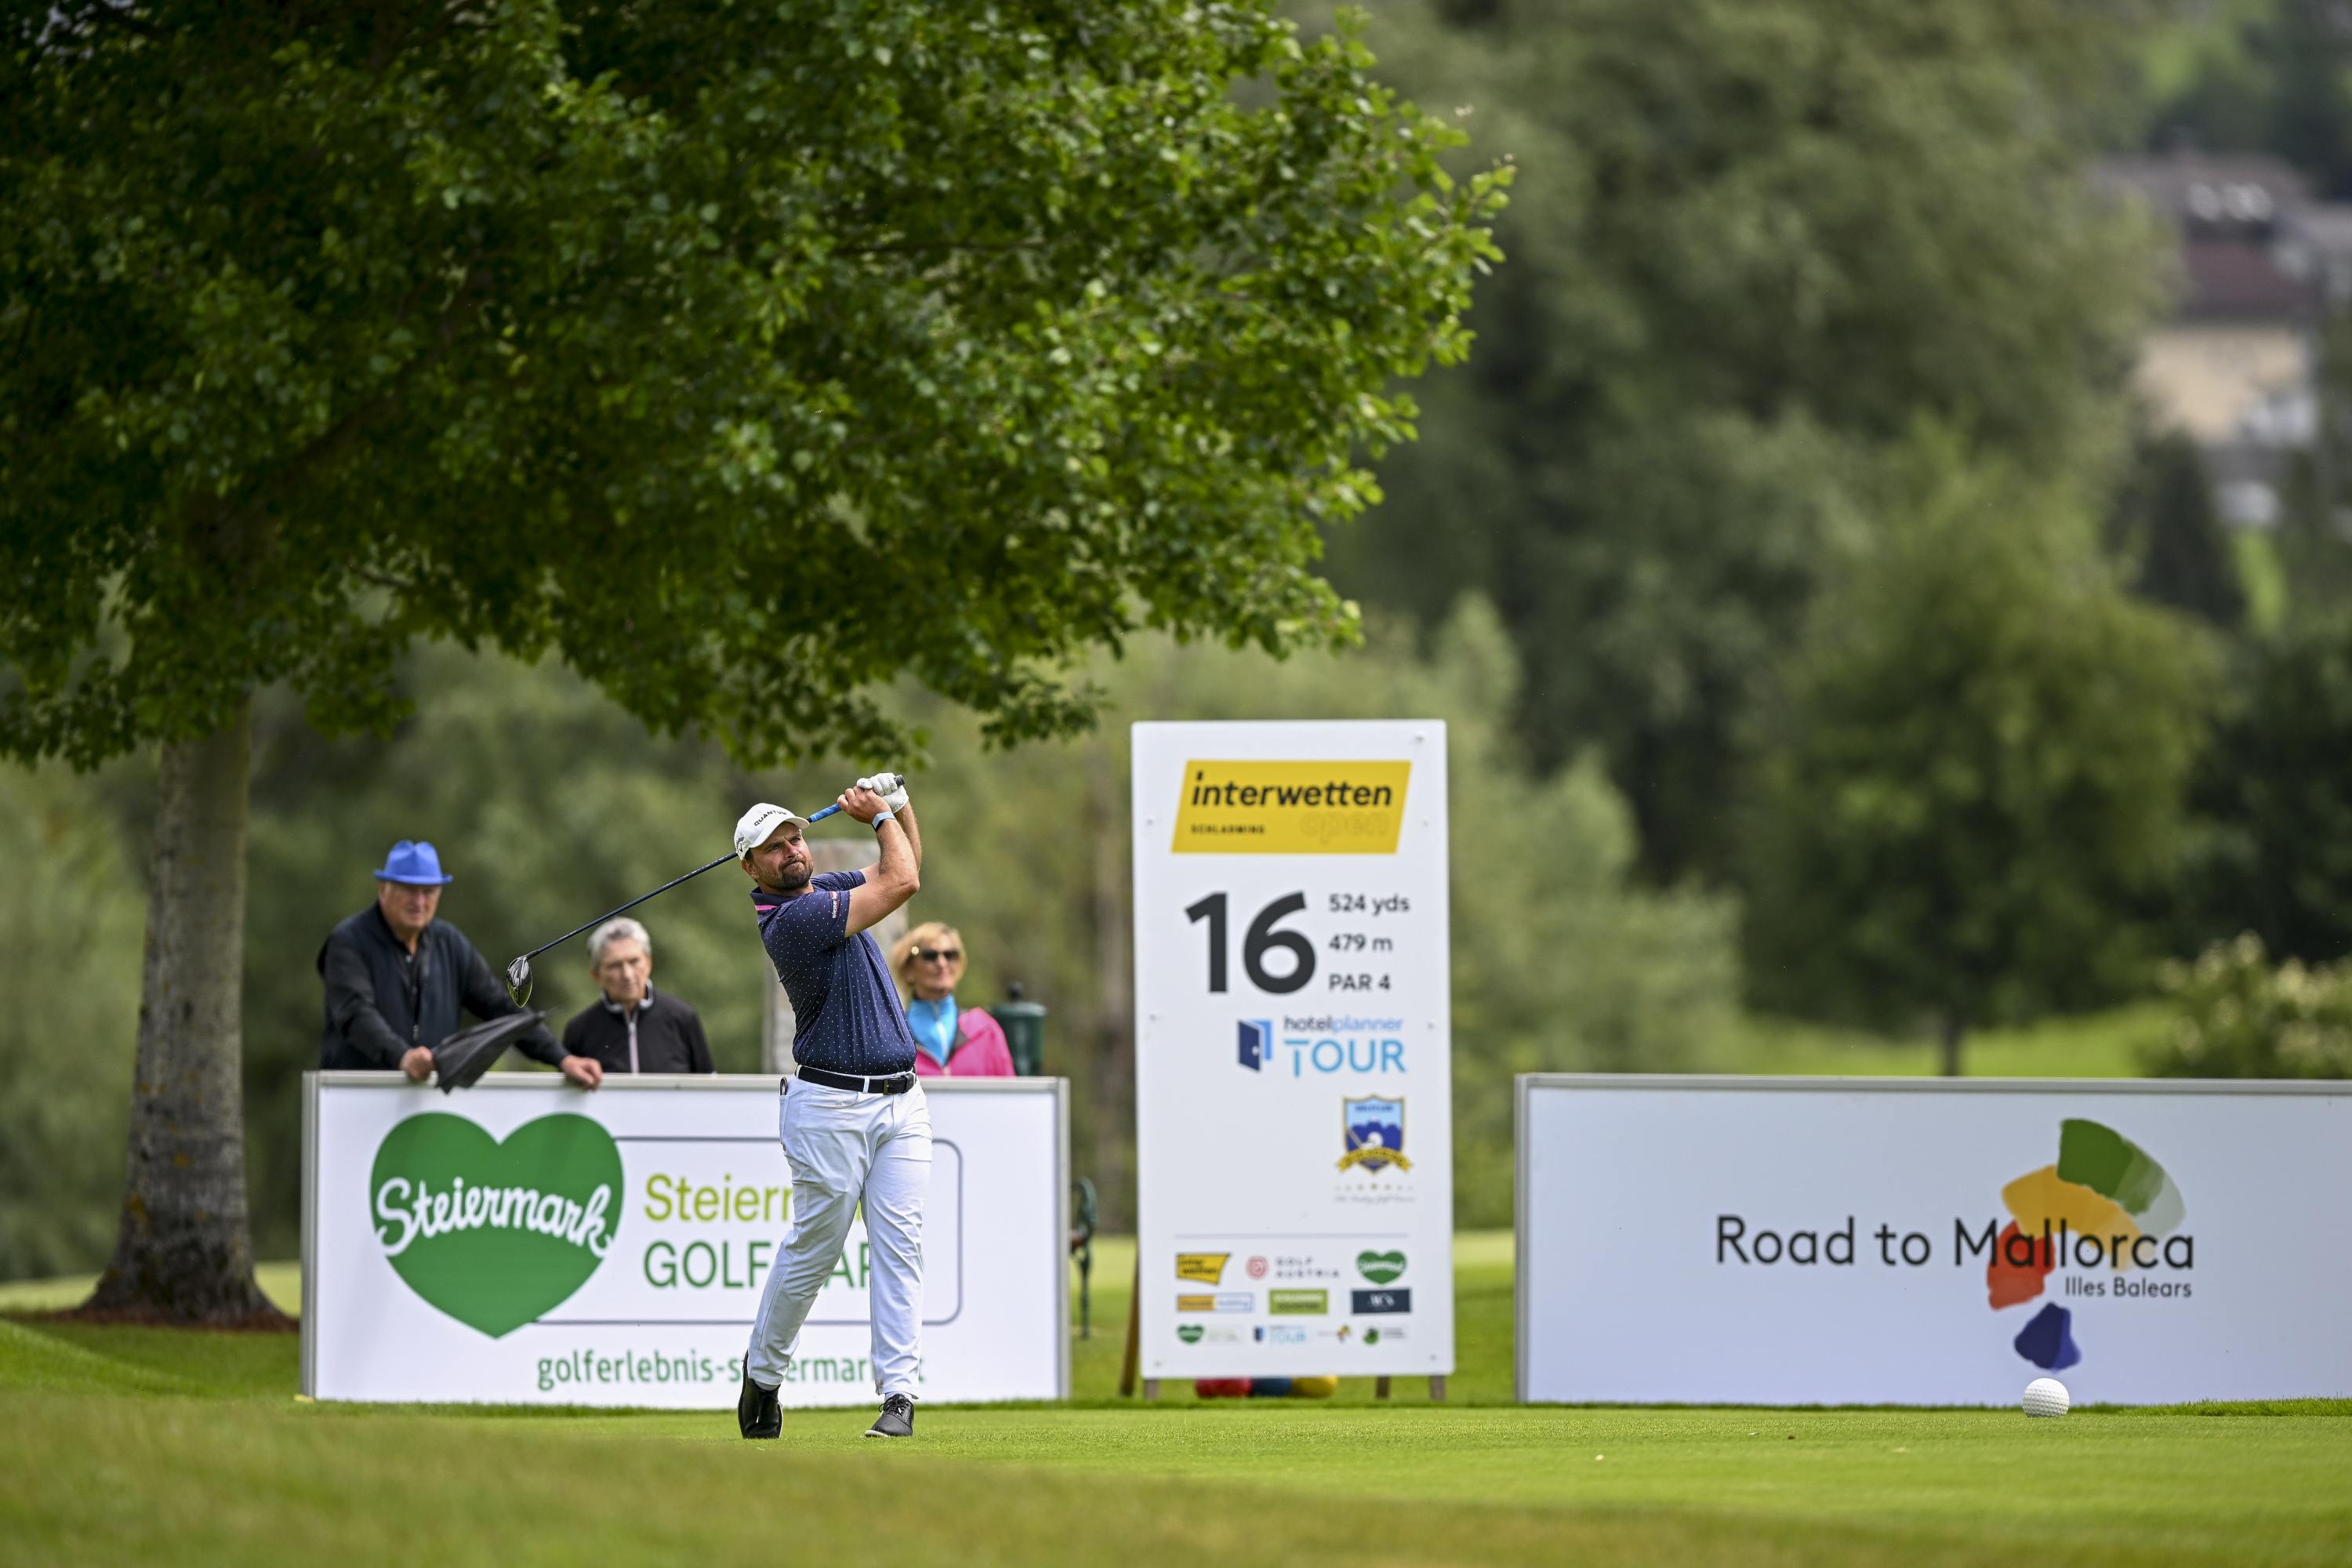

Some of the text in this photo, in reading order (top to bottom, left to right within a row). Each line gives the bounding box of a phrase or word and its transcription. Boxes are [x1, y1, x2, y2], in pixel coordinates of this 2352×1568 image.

[1191, 770, 1392, 807] interwetten
[753, 810, 787, 826] QUANTUM
[1190, 824, 1265, 834] SCHLADMING
[1300, 811, 1392, 844] open
[1329, 894, 1410, 916] 524 yds
[1184, 890, 1317, 996] 16
[1329, 934, 1393, 951] 479 m
[1329, 974, 1391, 991] PAR 4
[1283, 1015, 1402, 1033] hotelplanner
[1283, 1039, 1406, 1078] TOUR
[644, 1173, 864, 1222] Steier
[376, 1176, 614, 1258] Steiermark
[1717, 1214, 2194, 1269] Road to Mallorca
[2065, 1276, 2192, 1298] Illes Balears
